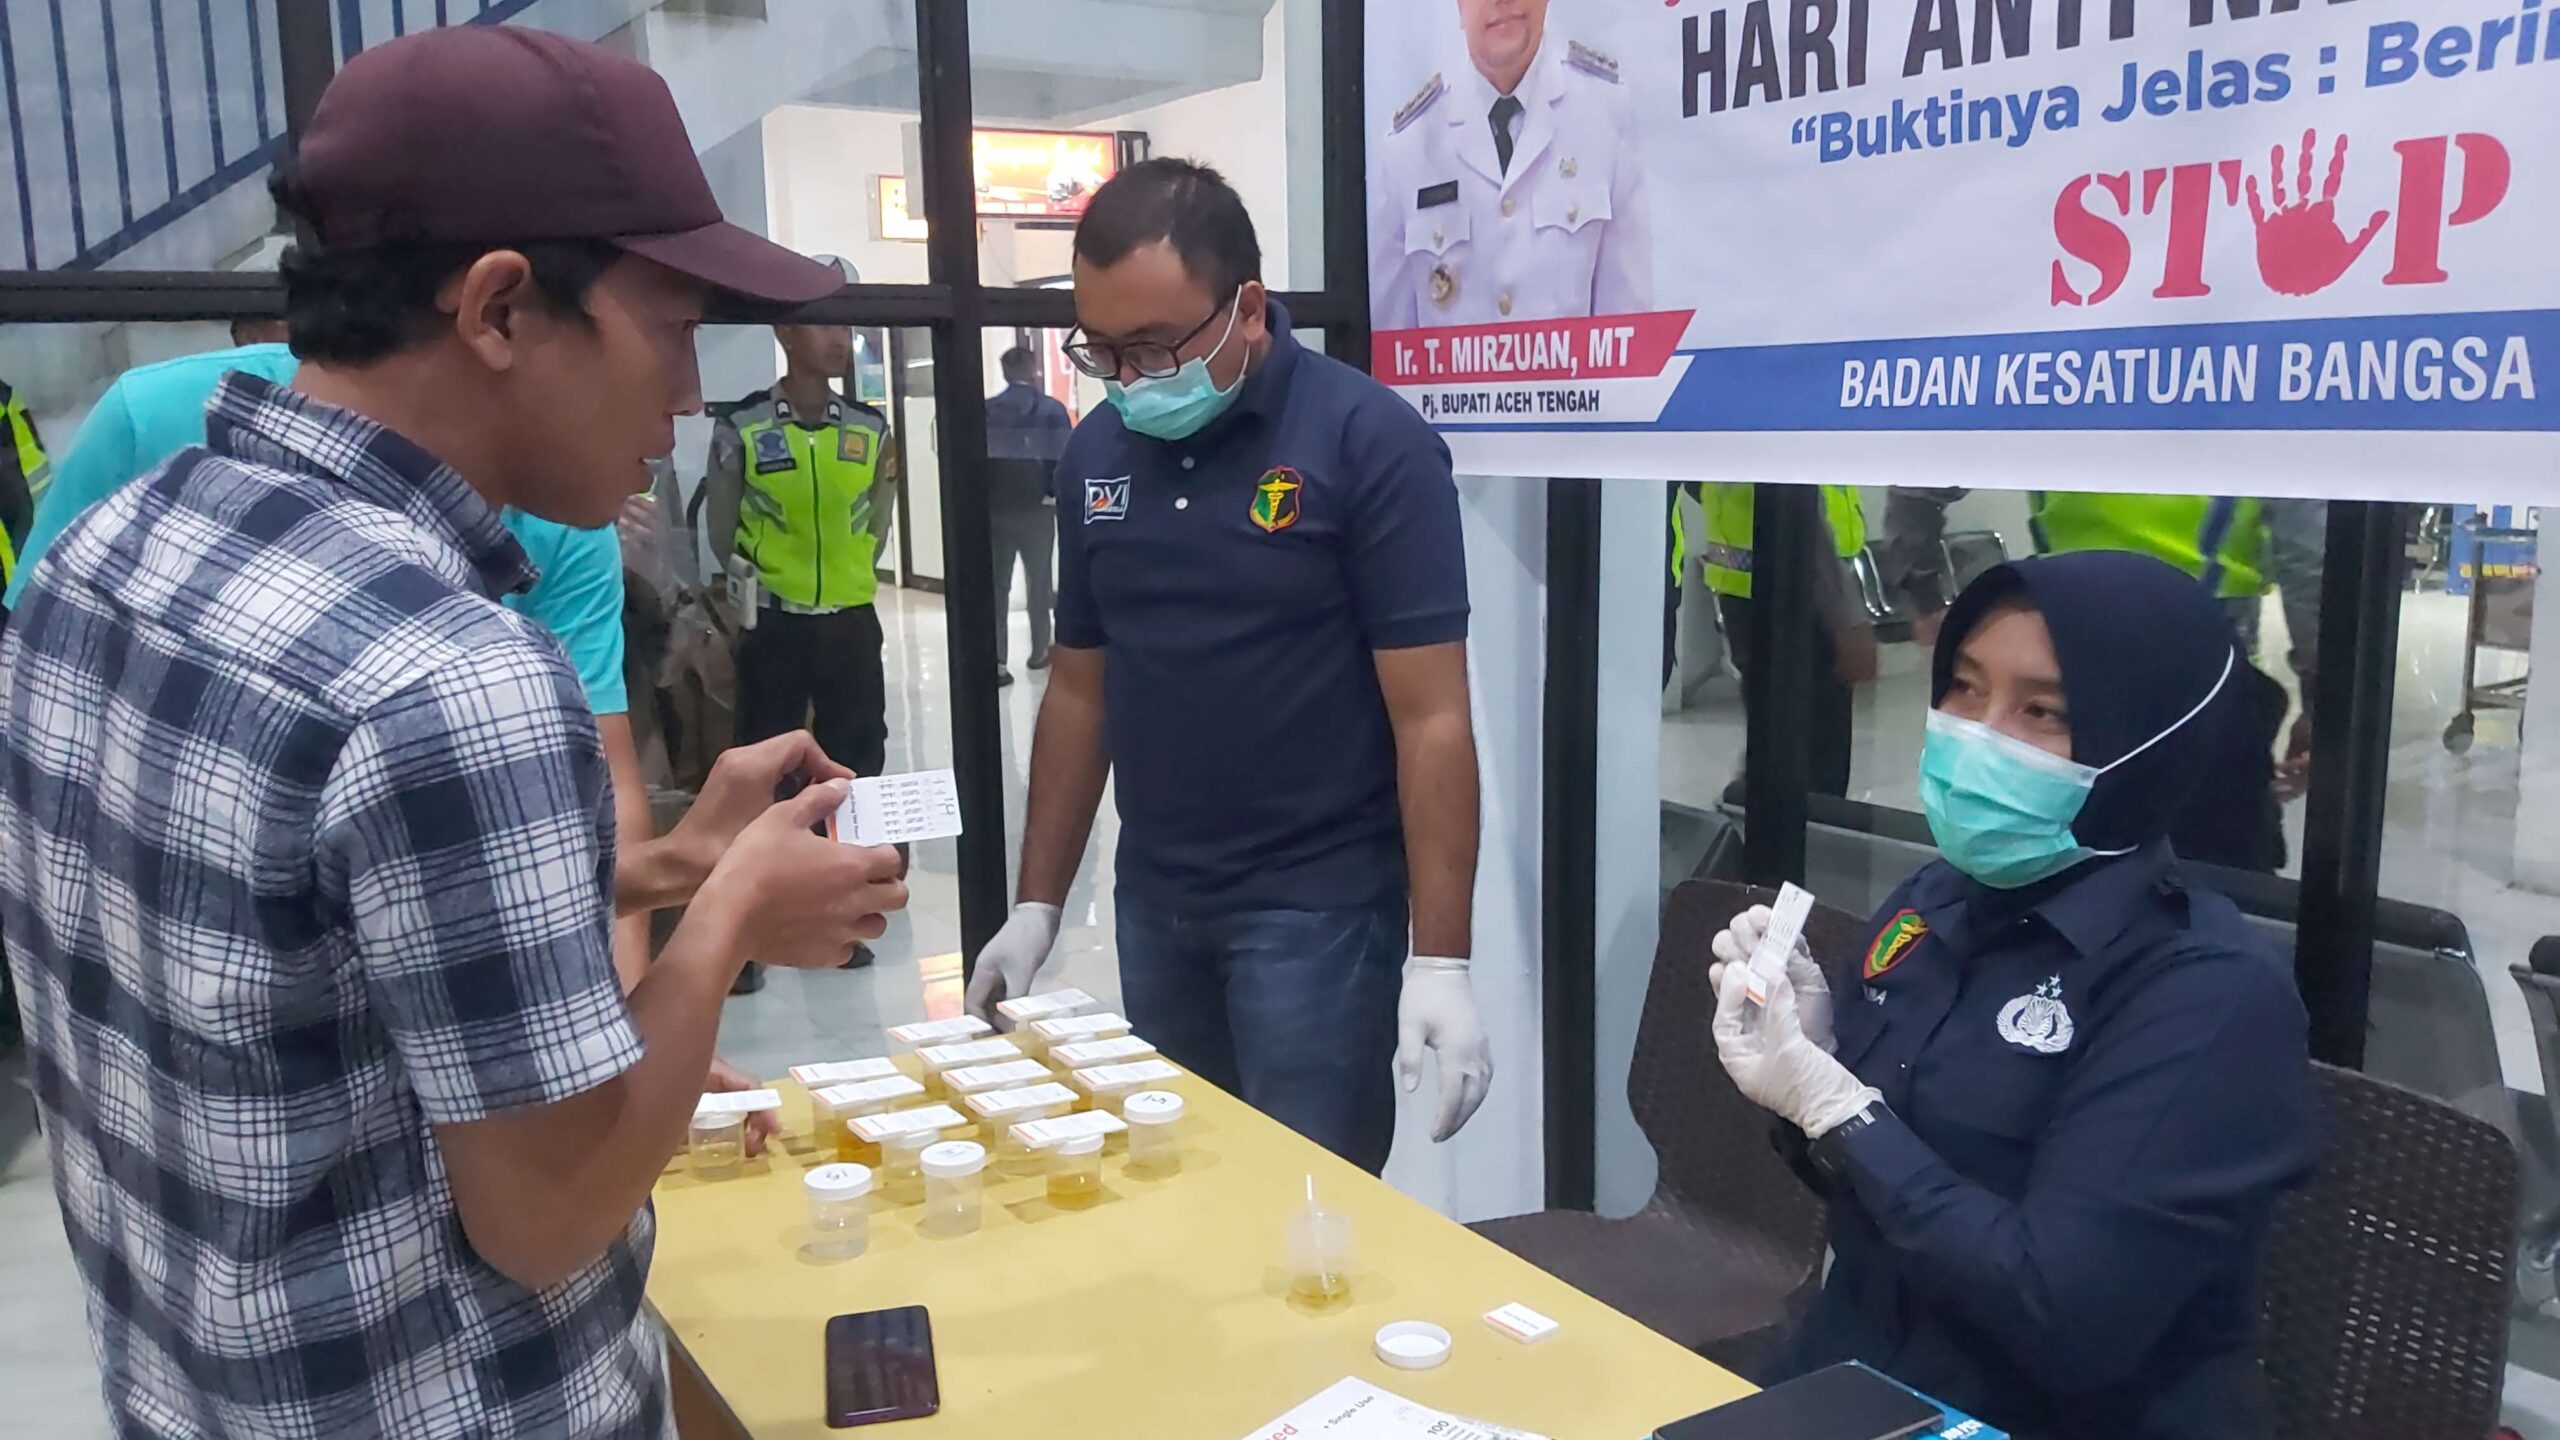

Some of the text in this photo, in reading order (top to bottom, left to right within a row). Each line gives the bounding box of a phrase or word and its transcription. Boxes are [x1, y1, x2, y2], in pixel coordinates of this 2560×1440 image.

[1682, 0, 1869, 119] HARI
[2101, 49, 2291, 122] Jelas
[2364, 0, 2560, 88] Beri
[1395, 326, 1635, 377] Ir. T. MIRZUAN, MT
[1840, 335, 2536, 408] BADAN KESATUAN BANGSA
[1421, 389, 1600, 419] Pj. BUPATI ACEH TENGAH
